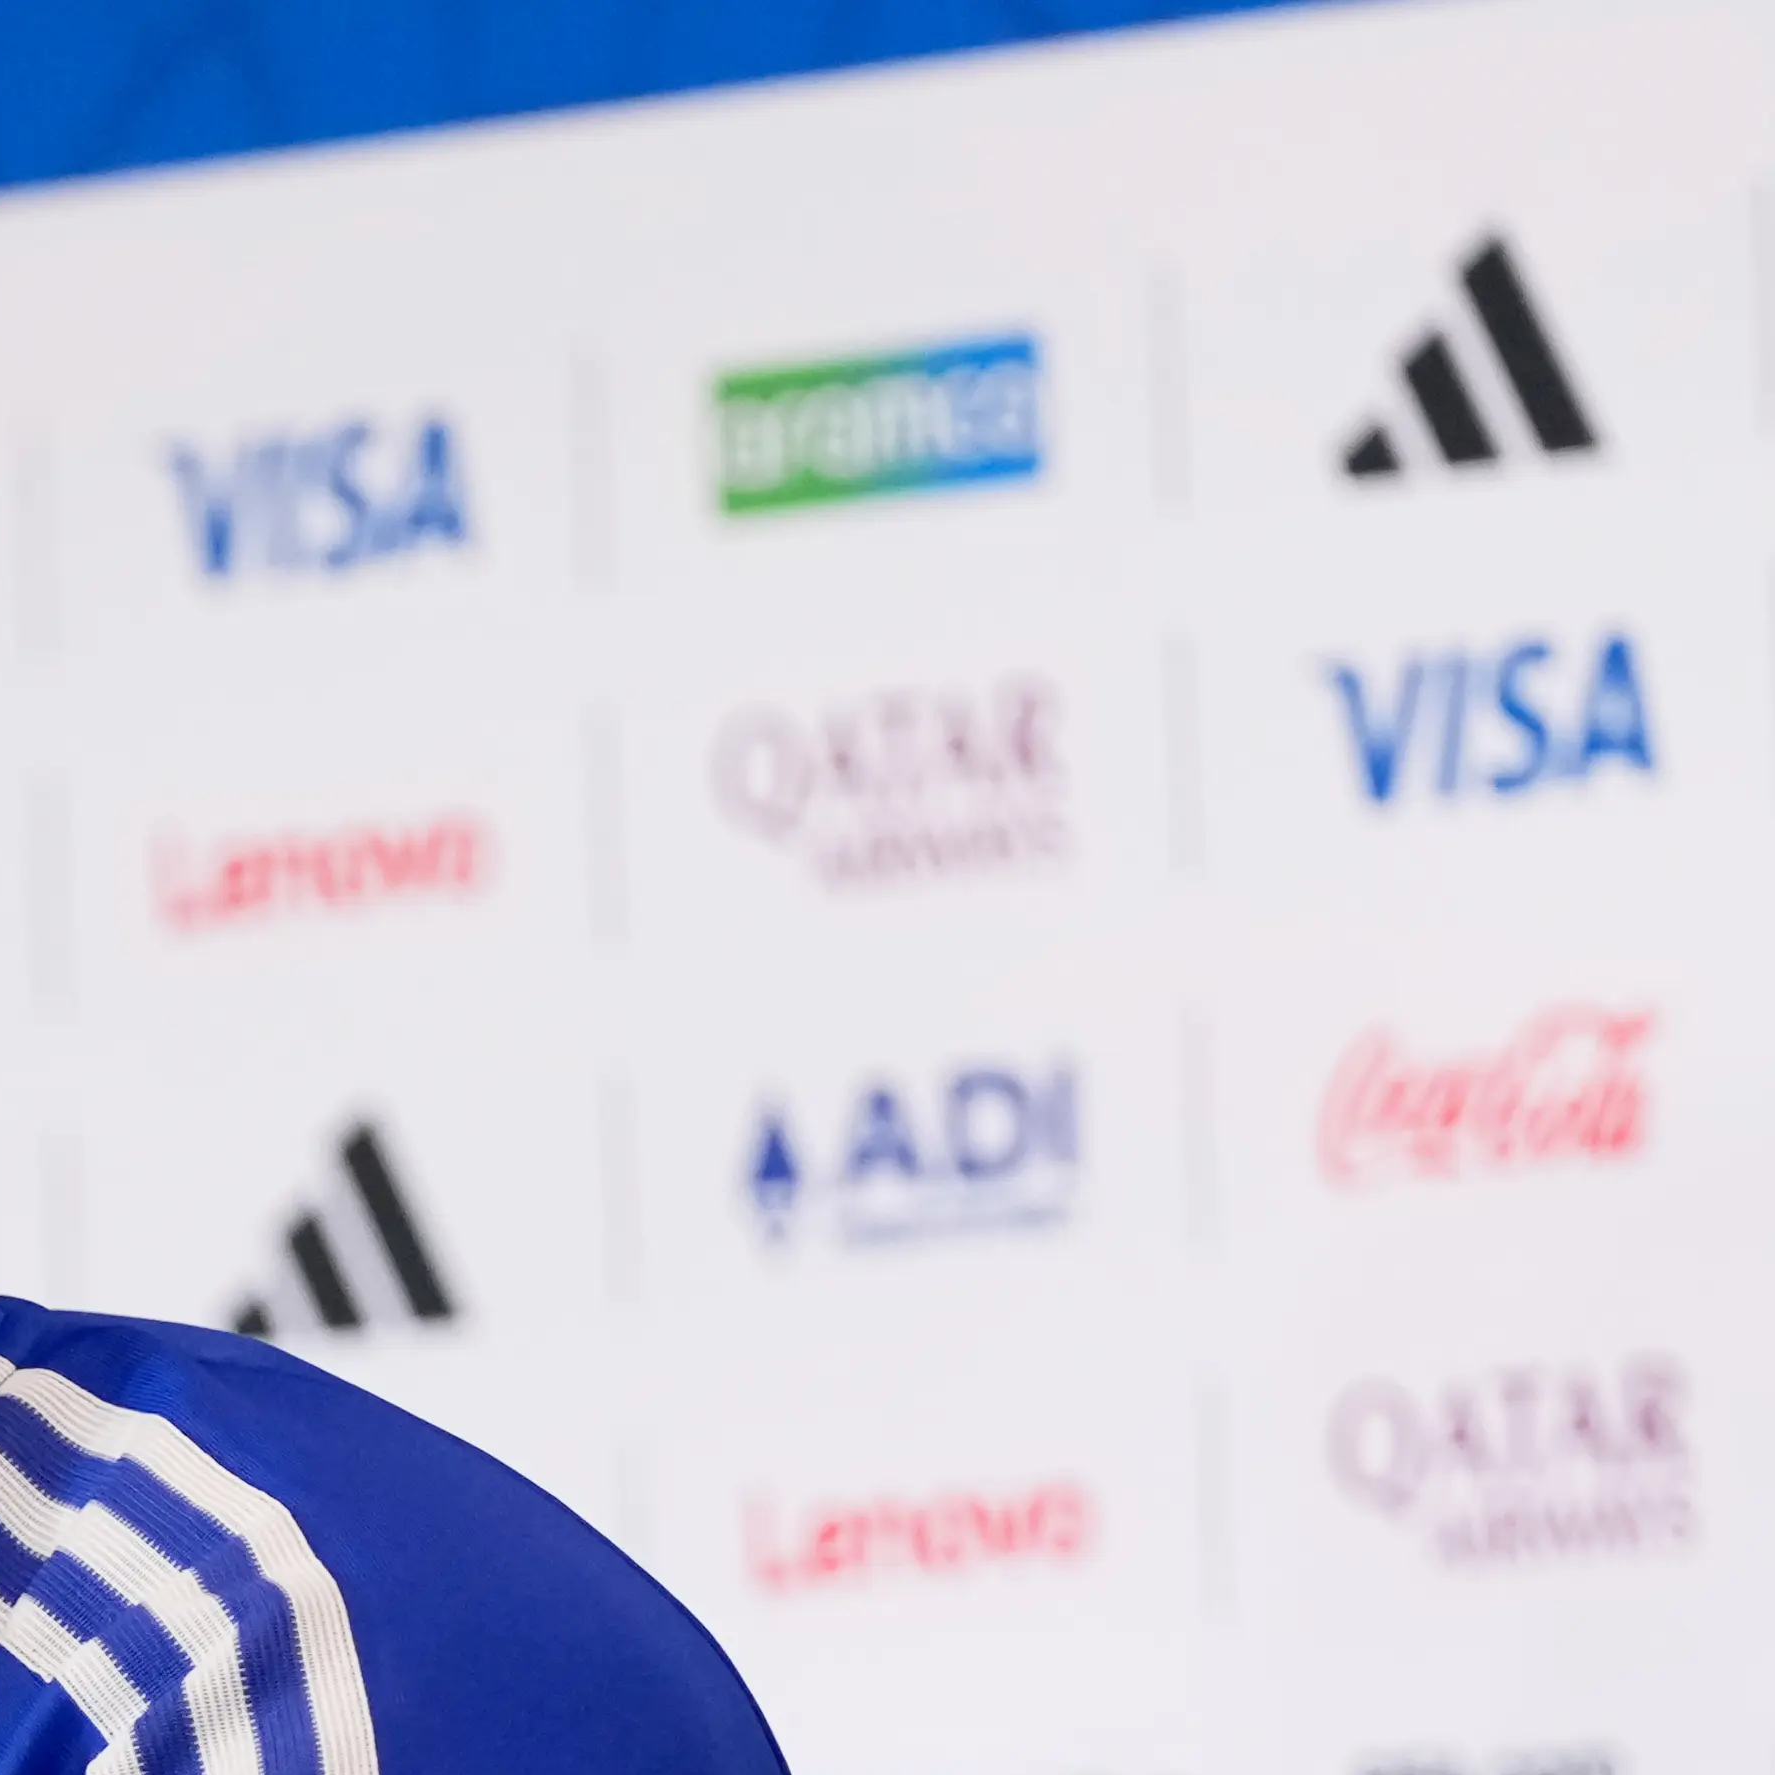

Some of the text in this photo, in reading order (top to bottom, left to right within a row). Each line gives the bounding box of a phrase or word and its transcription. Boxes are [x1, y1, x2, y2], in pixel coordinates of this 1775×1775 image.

[170, 414, 472, 580] VISA
[712, 676, 1064, 846] QATAR
[1330, 632, 1656, 806] VISA
[159, 817, 486, 931] Lenovo
[838, 1064, 1077, 1185] ADI
[1328, 1356, 1690, 1520] QATAR
[750, 1484, 1092, 1594] Lenovo
